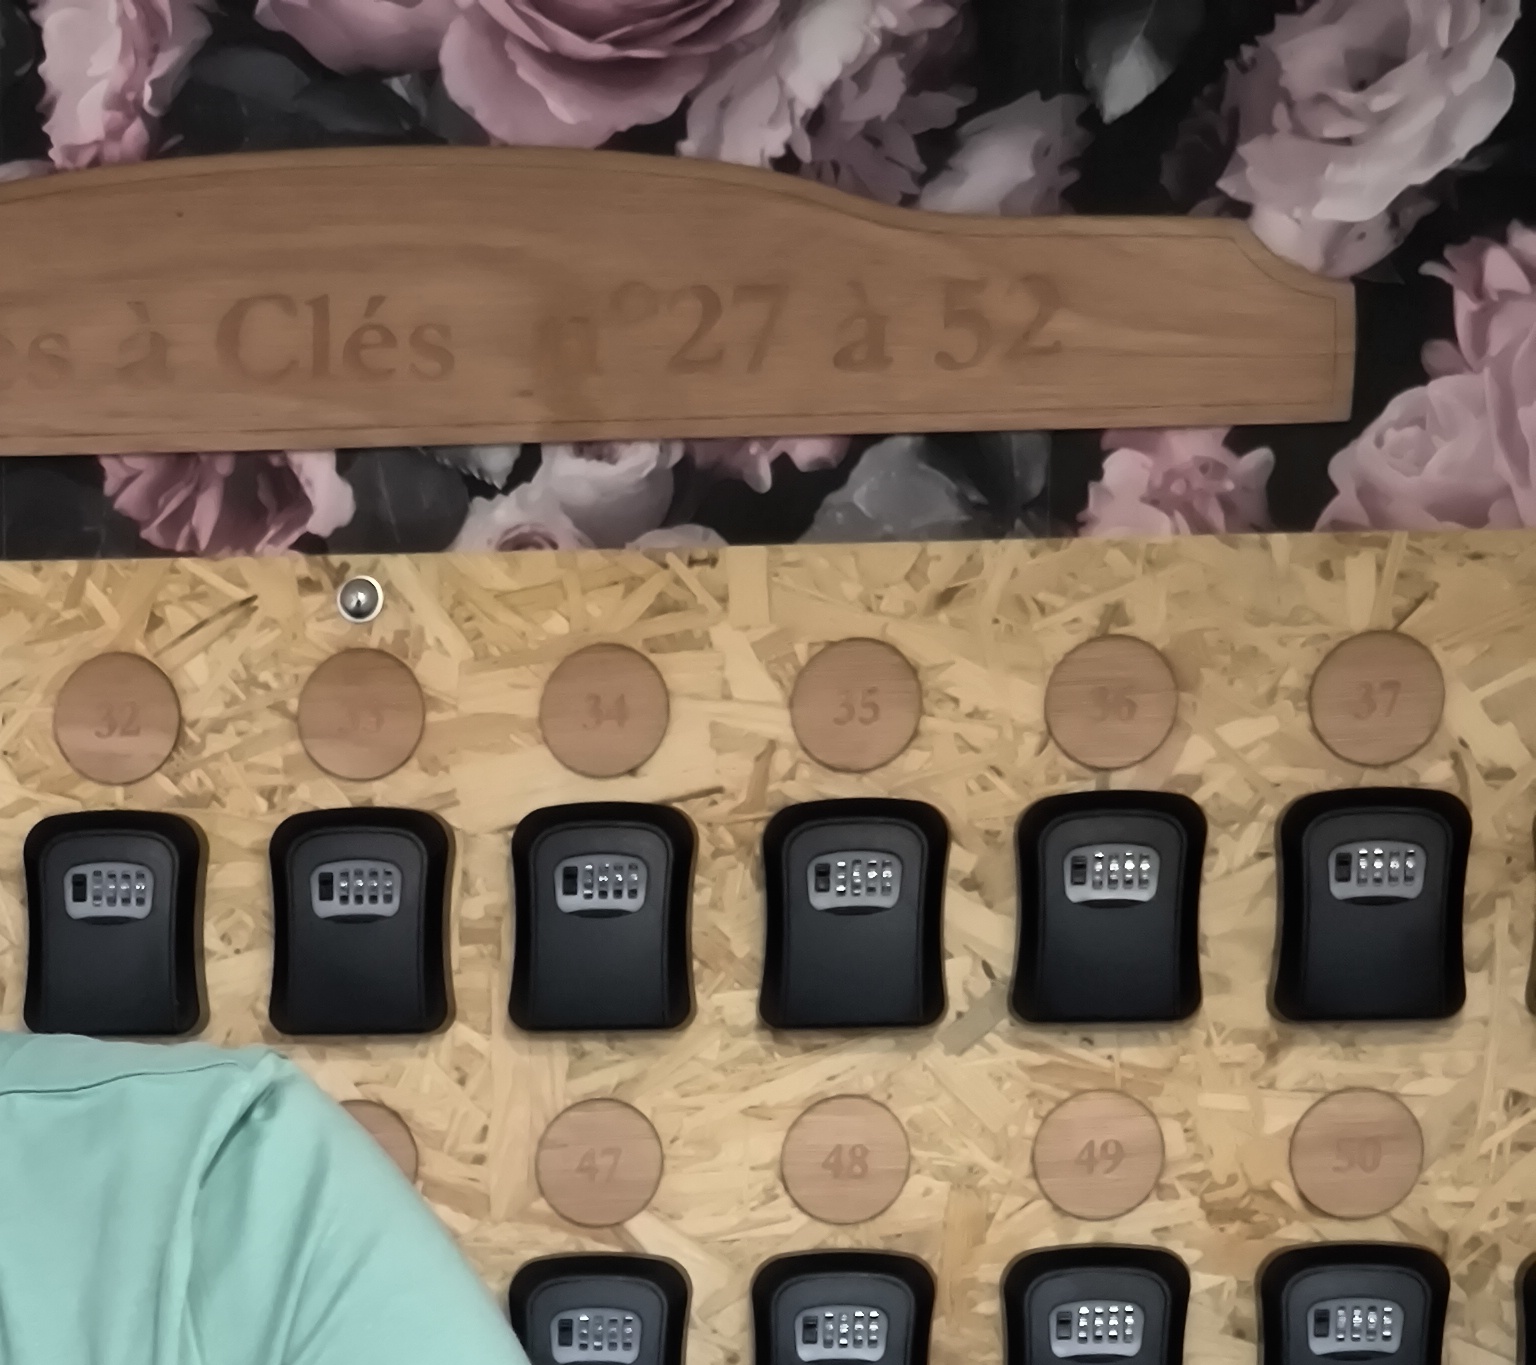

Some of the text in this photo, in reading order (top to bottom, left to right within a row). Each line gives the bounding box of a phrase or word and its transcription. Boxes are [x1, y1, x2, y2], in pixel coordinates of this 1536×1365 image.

[216, 294, 456, 382] Clés
[833, 280, 895, 373] à
[934, 273, 1063, 371] 52
[832, 685, 881, 726] 35
[1351, 679, 1402, 721] 37
[95, 701, 142, 739] 32
[575, 1146, 623, 1182] 47
[820, 1143, 870, 1180] 48
[1074, 1138, 1125, 1175] 49
